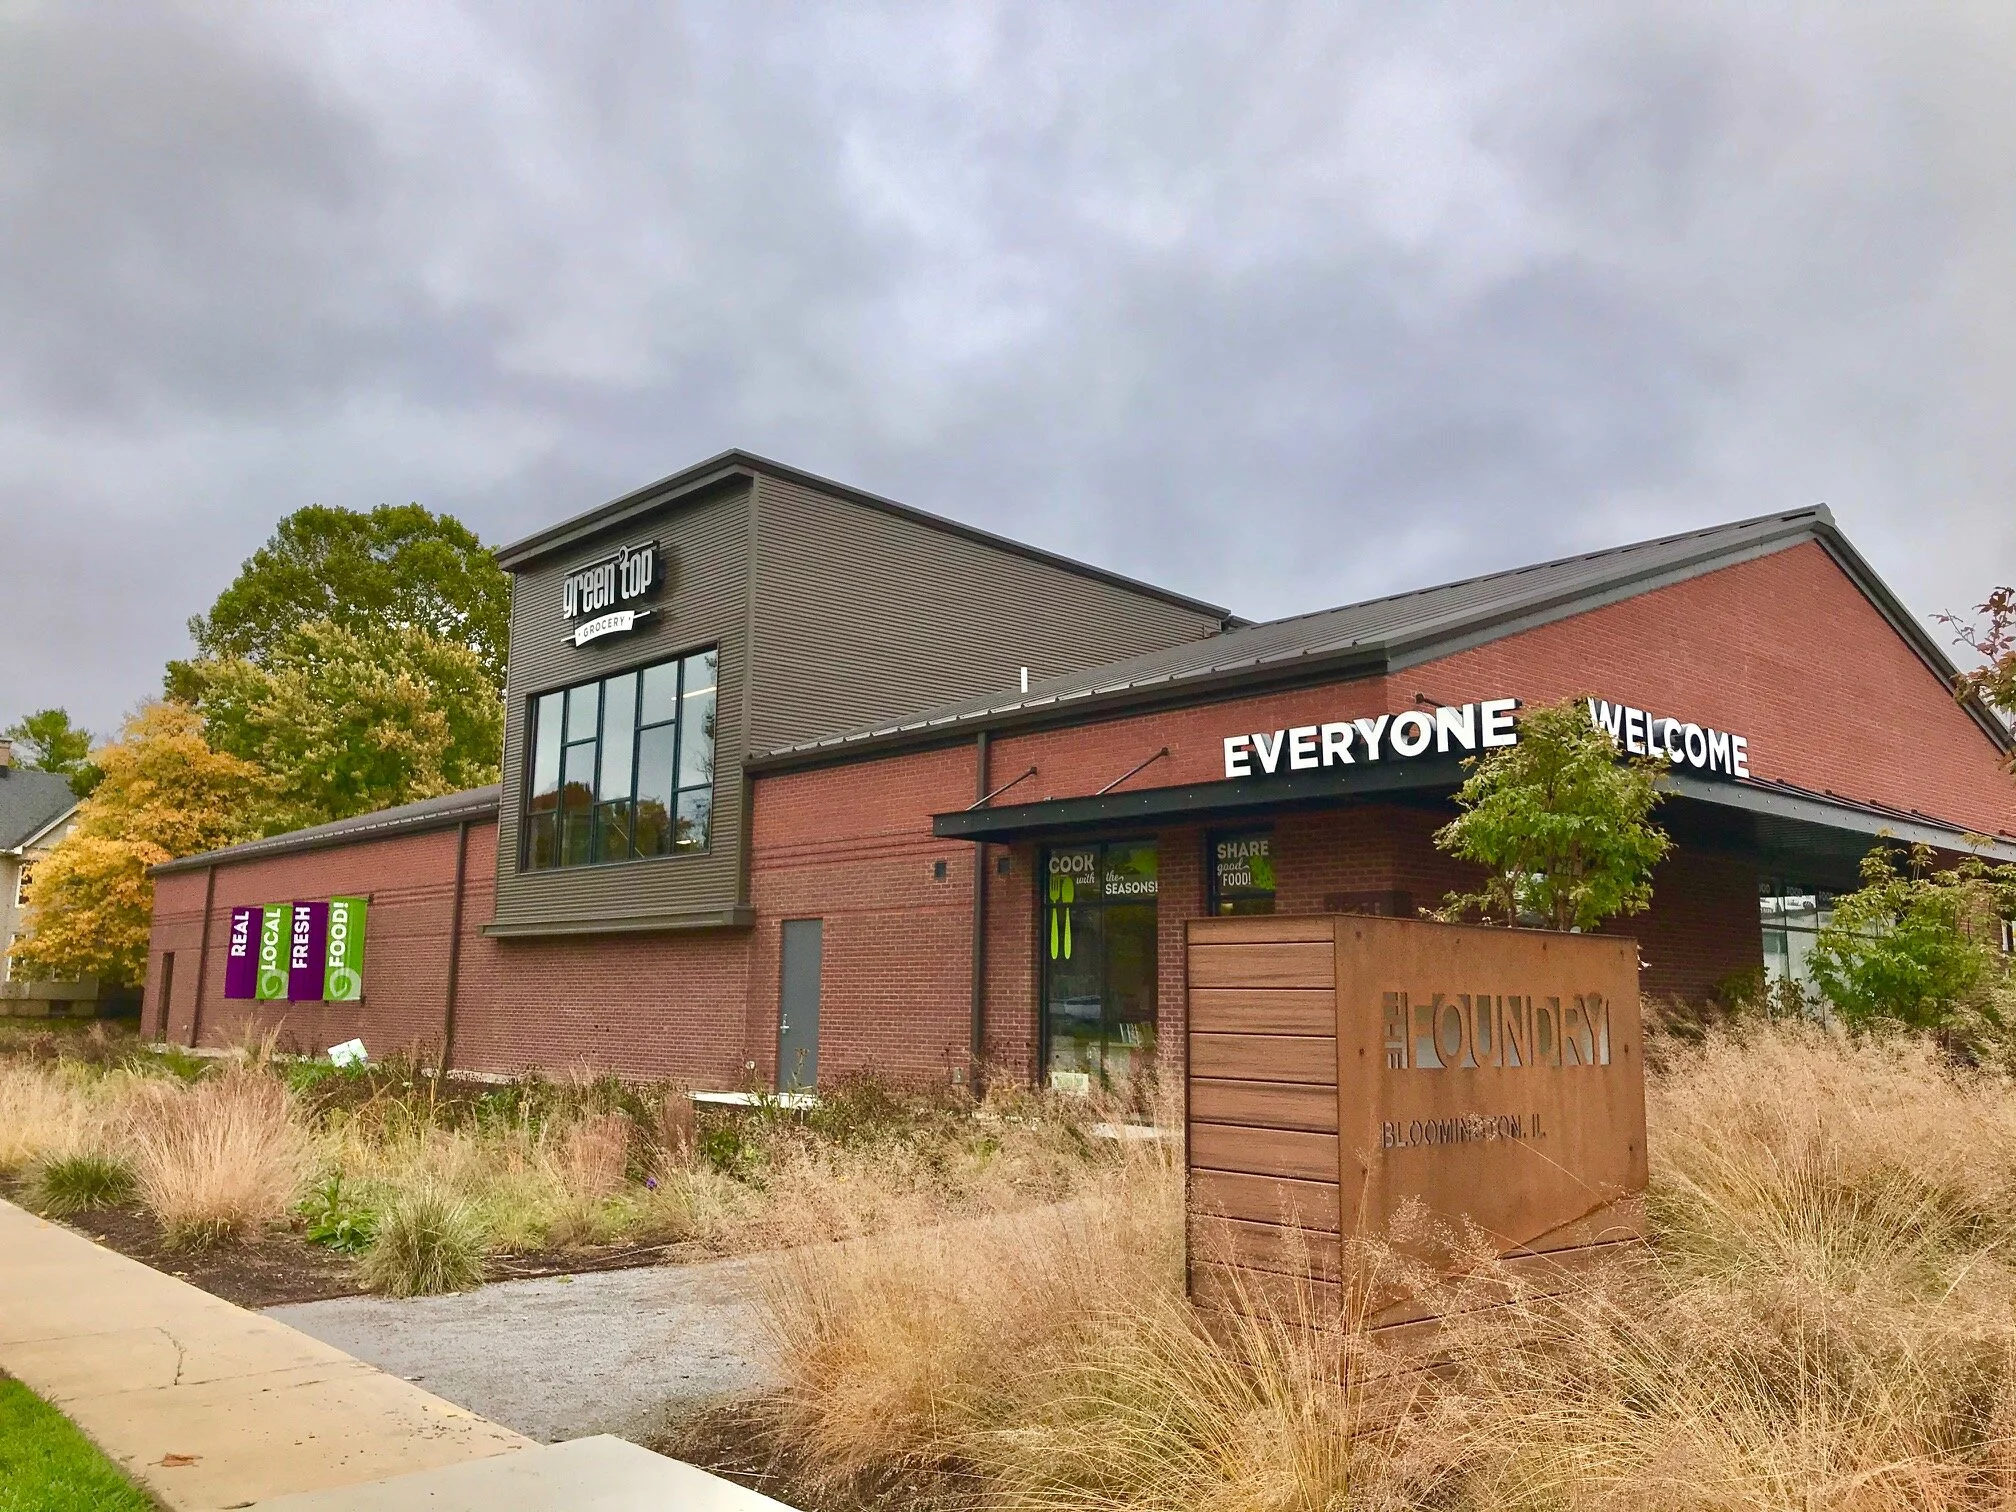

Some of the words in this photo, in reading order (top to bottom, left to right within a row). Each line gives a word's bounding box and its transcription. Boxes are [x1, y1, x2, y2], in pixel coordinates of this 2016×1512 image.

[562, 562, 616, 620] green
[618, 545, 653, 600] top
[583, 615, 625, 637] GROCERY
[1223, 698, 1518, 778] EVERYONE
[1587, 697, 1750, 779] WELCOME
[1217, 840, 1269, 859] SHARE
[1048, 853, 1095, 874] COOK
[1217, 857, 1250, 876] good
[1076, 871, 1095, 885] with
[1105, 869, 1125, 882] the
[1222, 871, 1251, 886] FOOD!
[1105, 880, 1159, 895] SEASONS!
[231, 911, 250, 957] REAL
[260, 908, 282, 970] LOCAL
[292, 906, 311, 969] FRESH
[328, 902, 349, 968] FOOD!
[1408, 991, 1610, 1069] FOUNDRY
